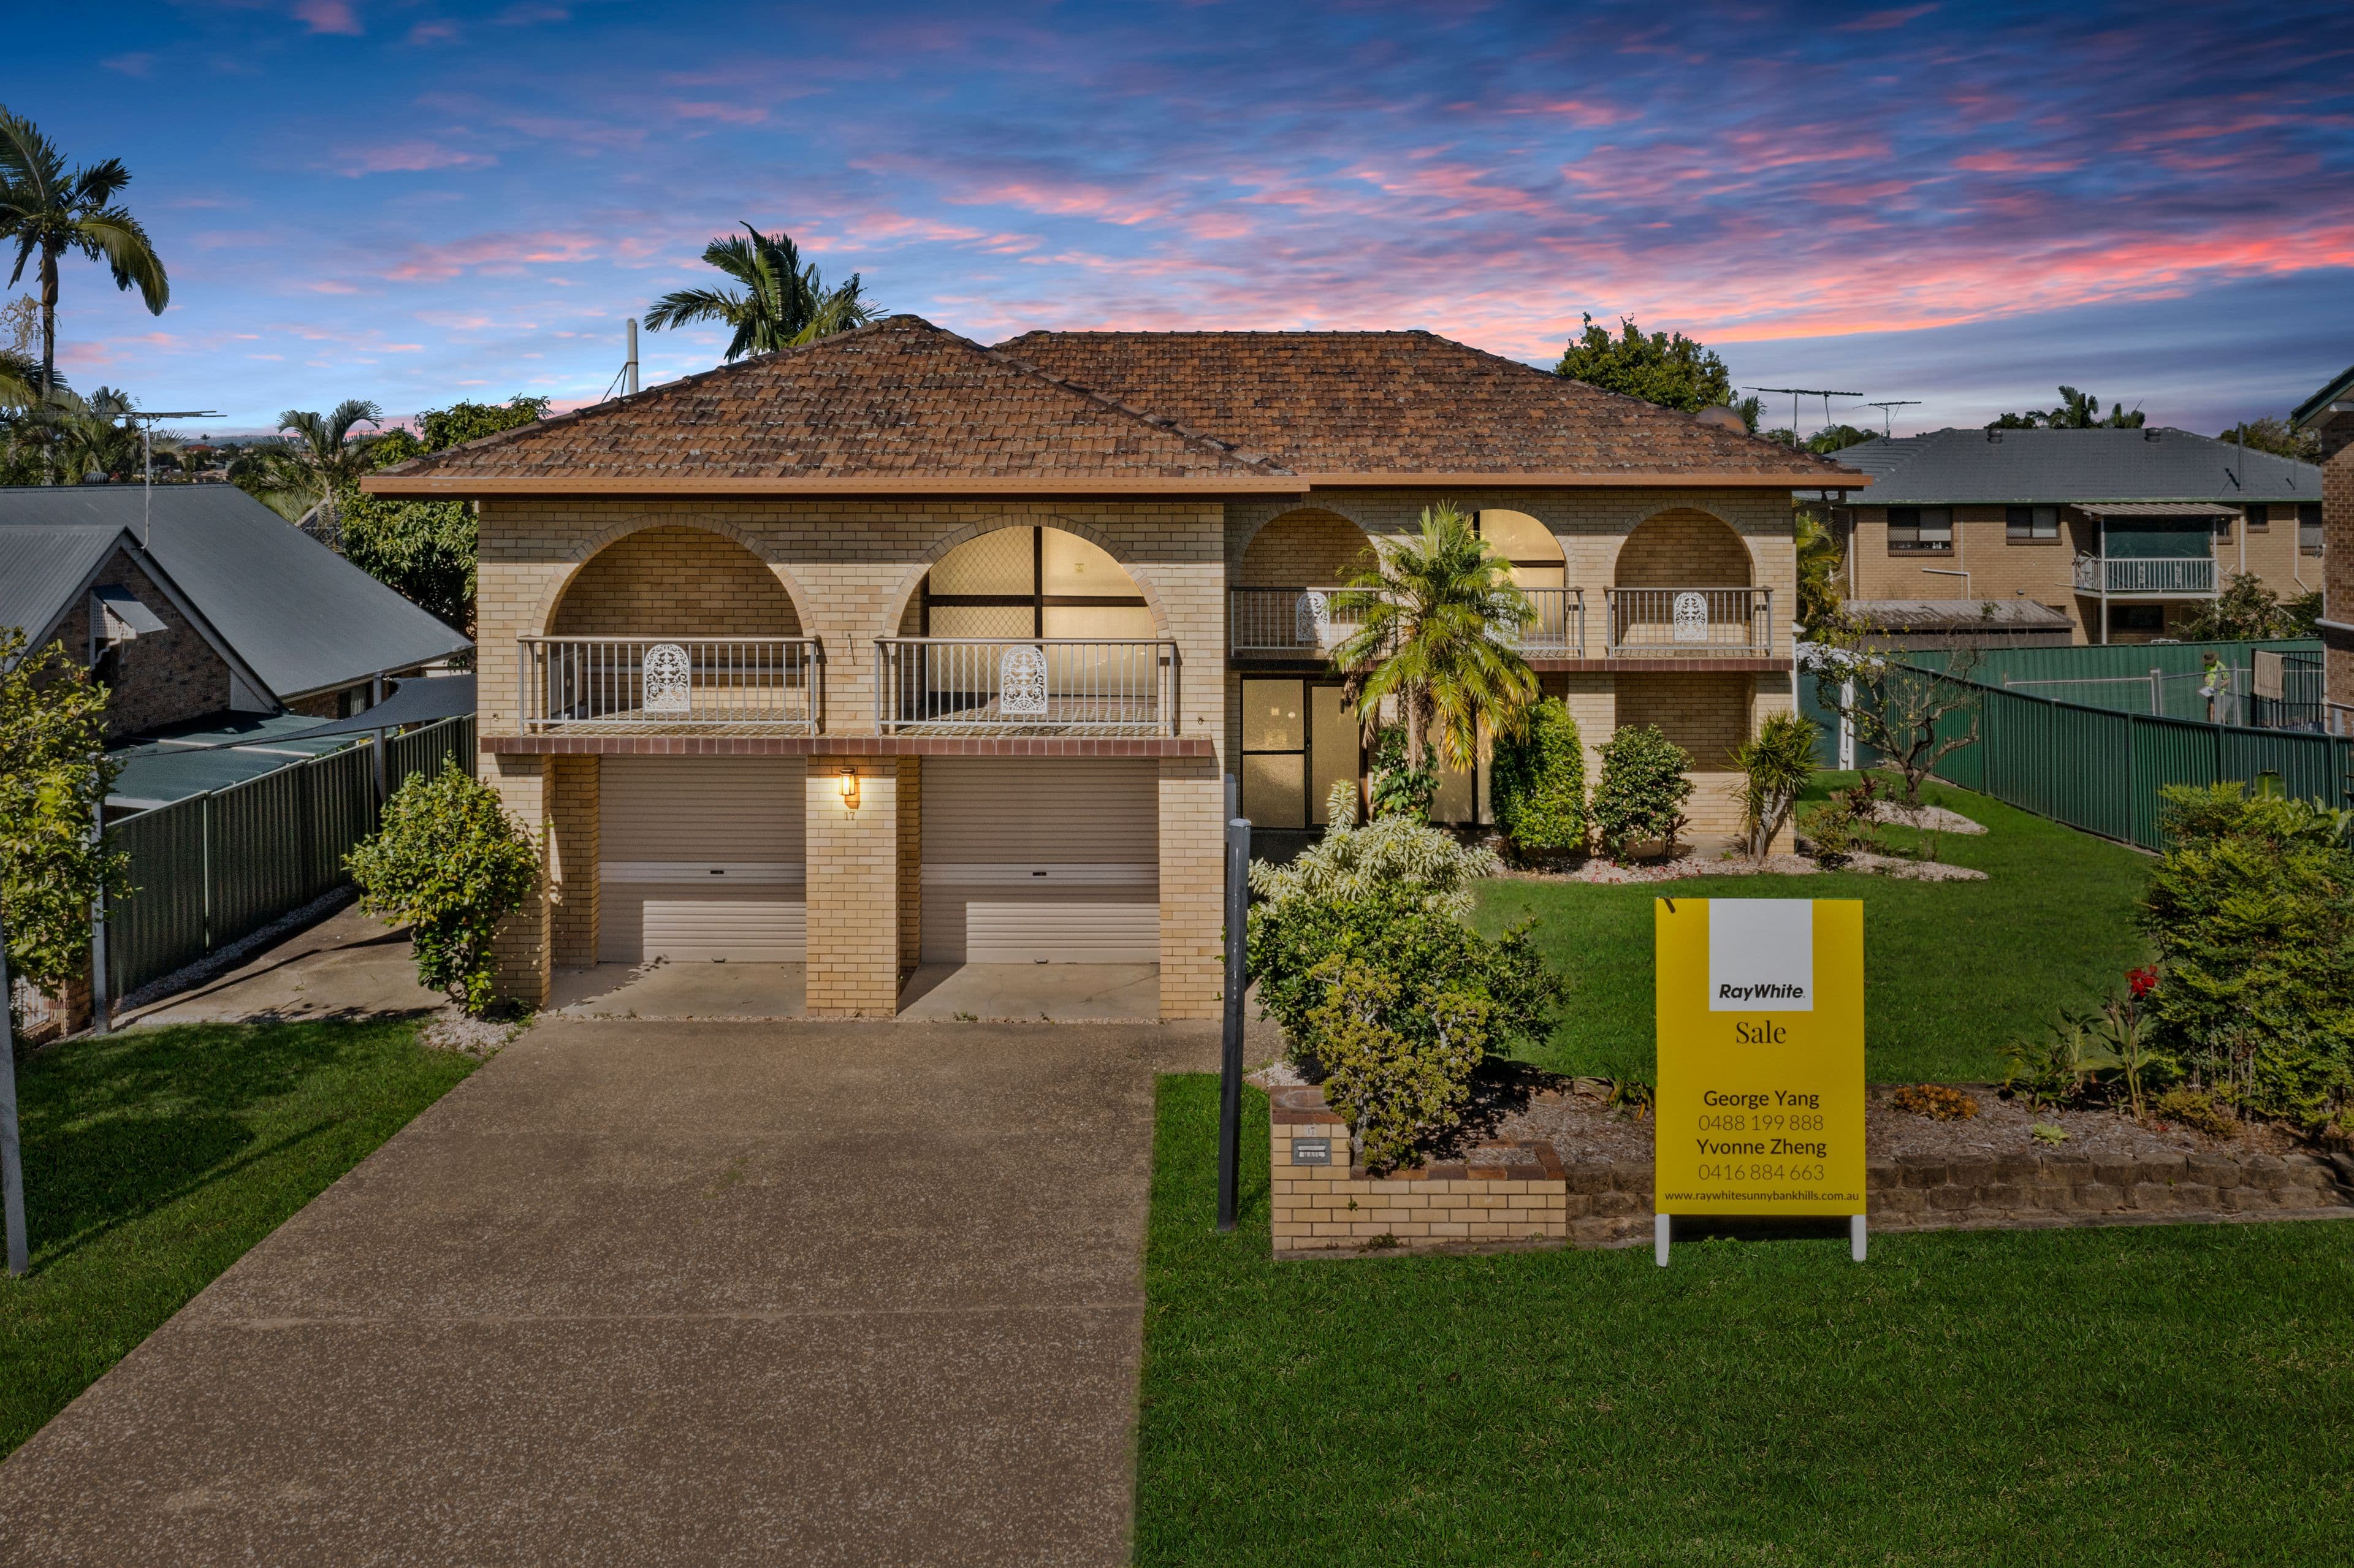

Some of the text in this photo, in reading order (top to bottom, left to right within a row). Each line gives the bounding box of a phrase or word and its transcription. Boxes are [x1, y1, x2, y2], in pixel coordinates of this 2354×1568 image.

[844, 812, 855, 821] 17
[1719, 984, 1804, 1001] RayWhite
[1736, 1020, 1786, 1044] Sale
[1704, 1090, 1820, 1109] George Yang
[1699, 1115, 1824, 1131] 0488 199 888
[1696, 1139, 1827, 1158] Yvonne Zheng
[1698, 1164, 1824, 1181] 0416 884 663
[1664, 1190, 1859, 1202] www.raywhitesunnybankhills.com.au
